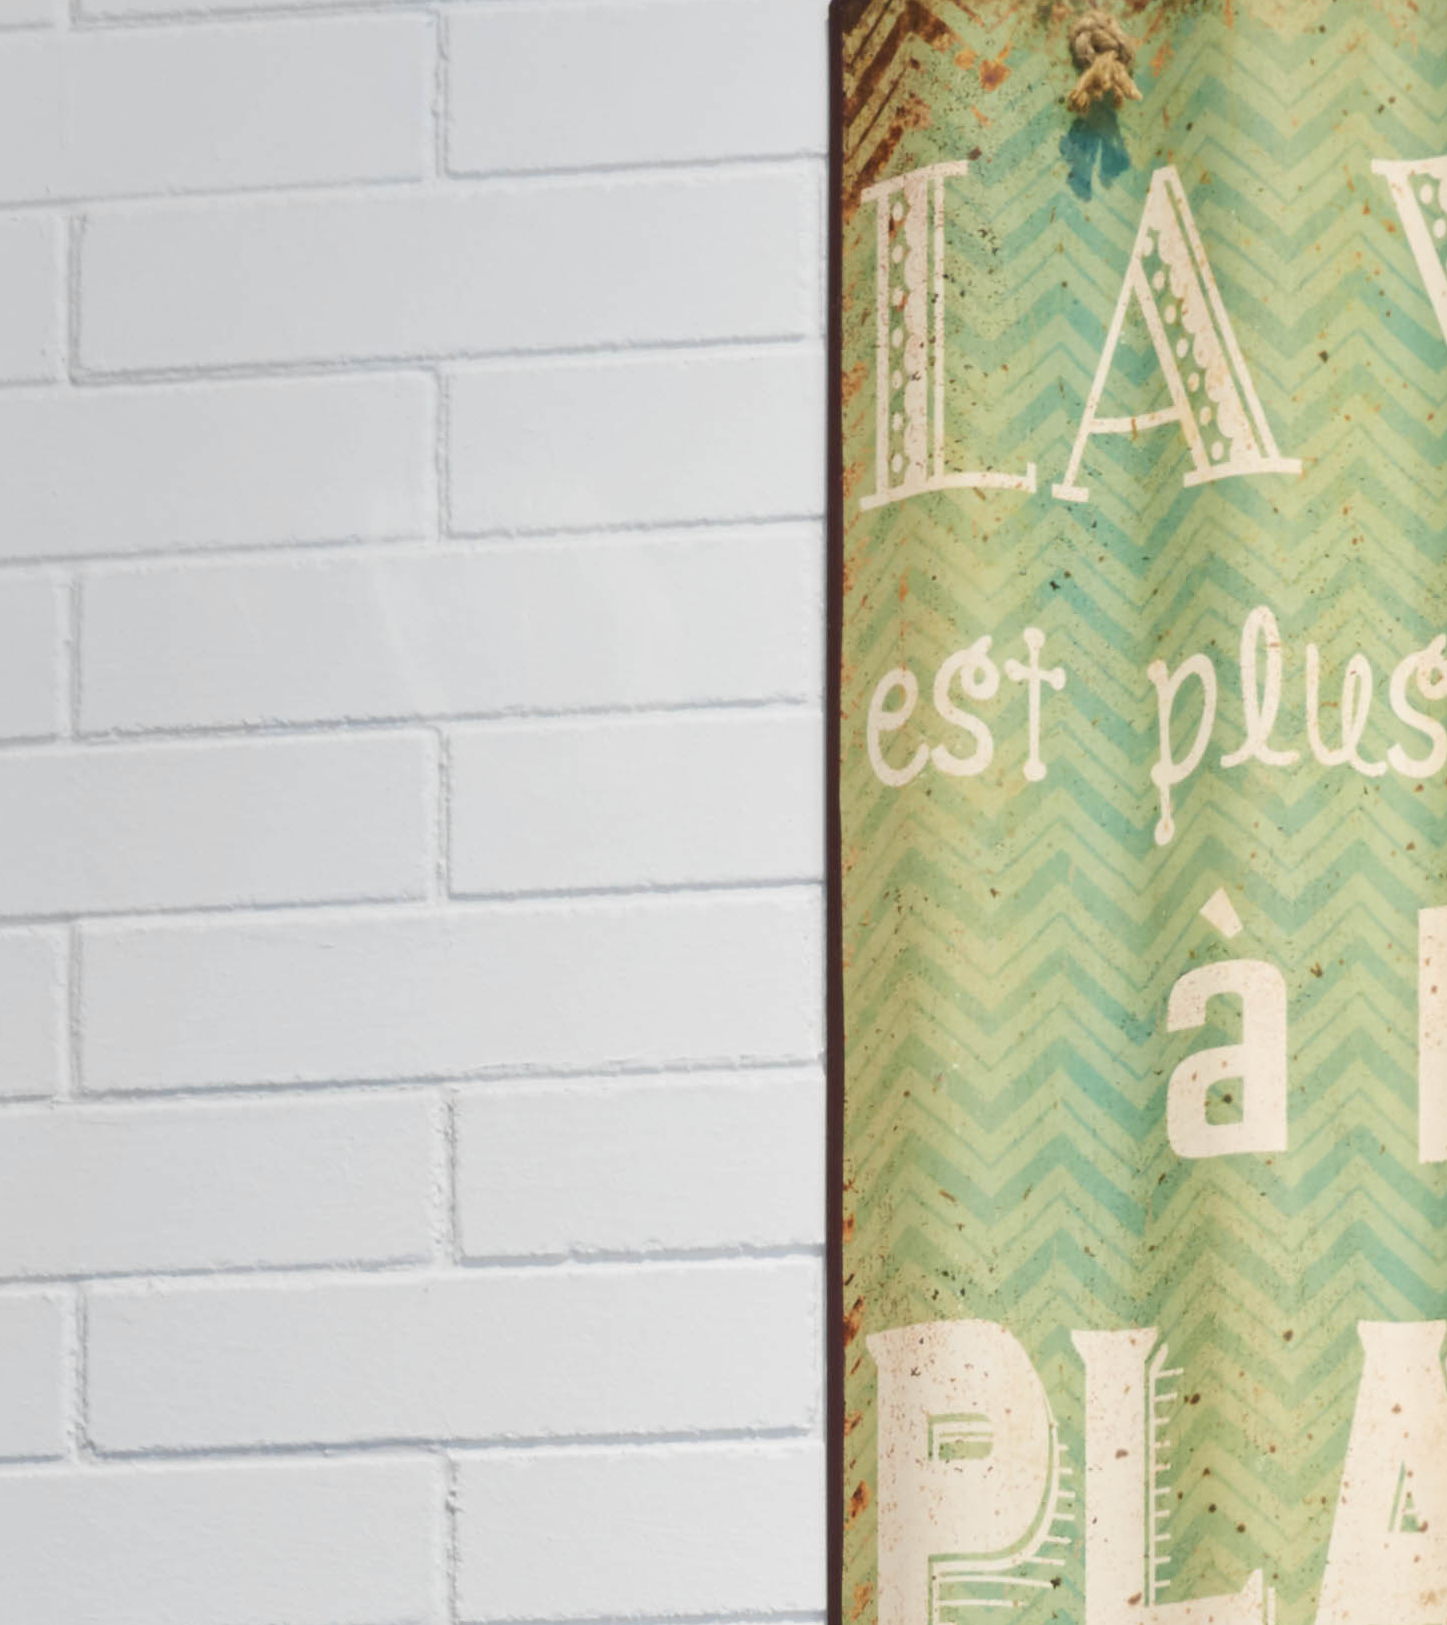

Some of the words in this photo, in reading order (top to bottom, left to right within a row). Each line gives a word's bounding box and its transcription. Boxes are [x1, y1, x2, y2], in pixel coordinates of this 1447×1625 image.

[858, 159, 1303, 512] LA
[865, 626, 1067, 788] est
[1165, 886, 1288, 1159] à
